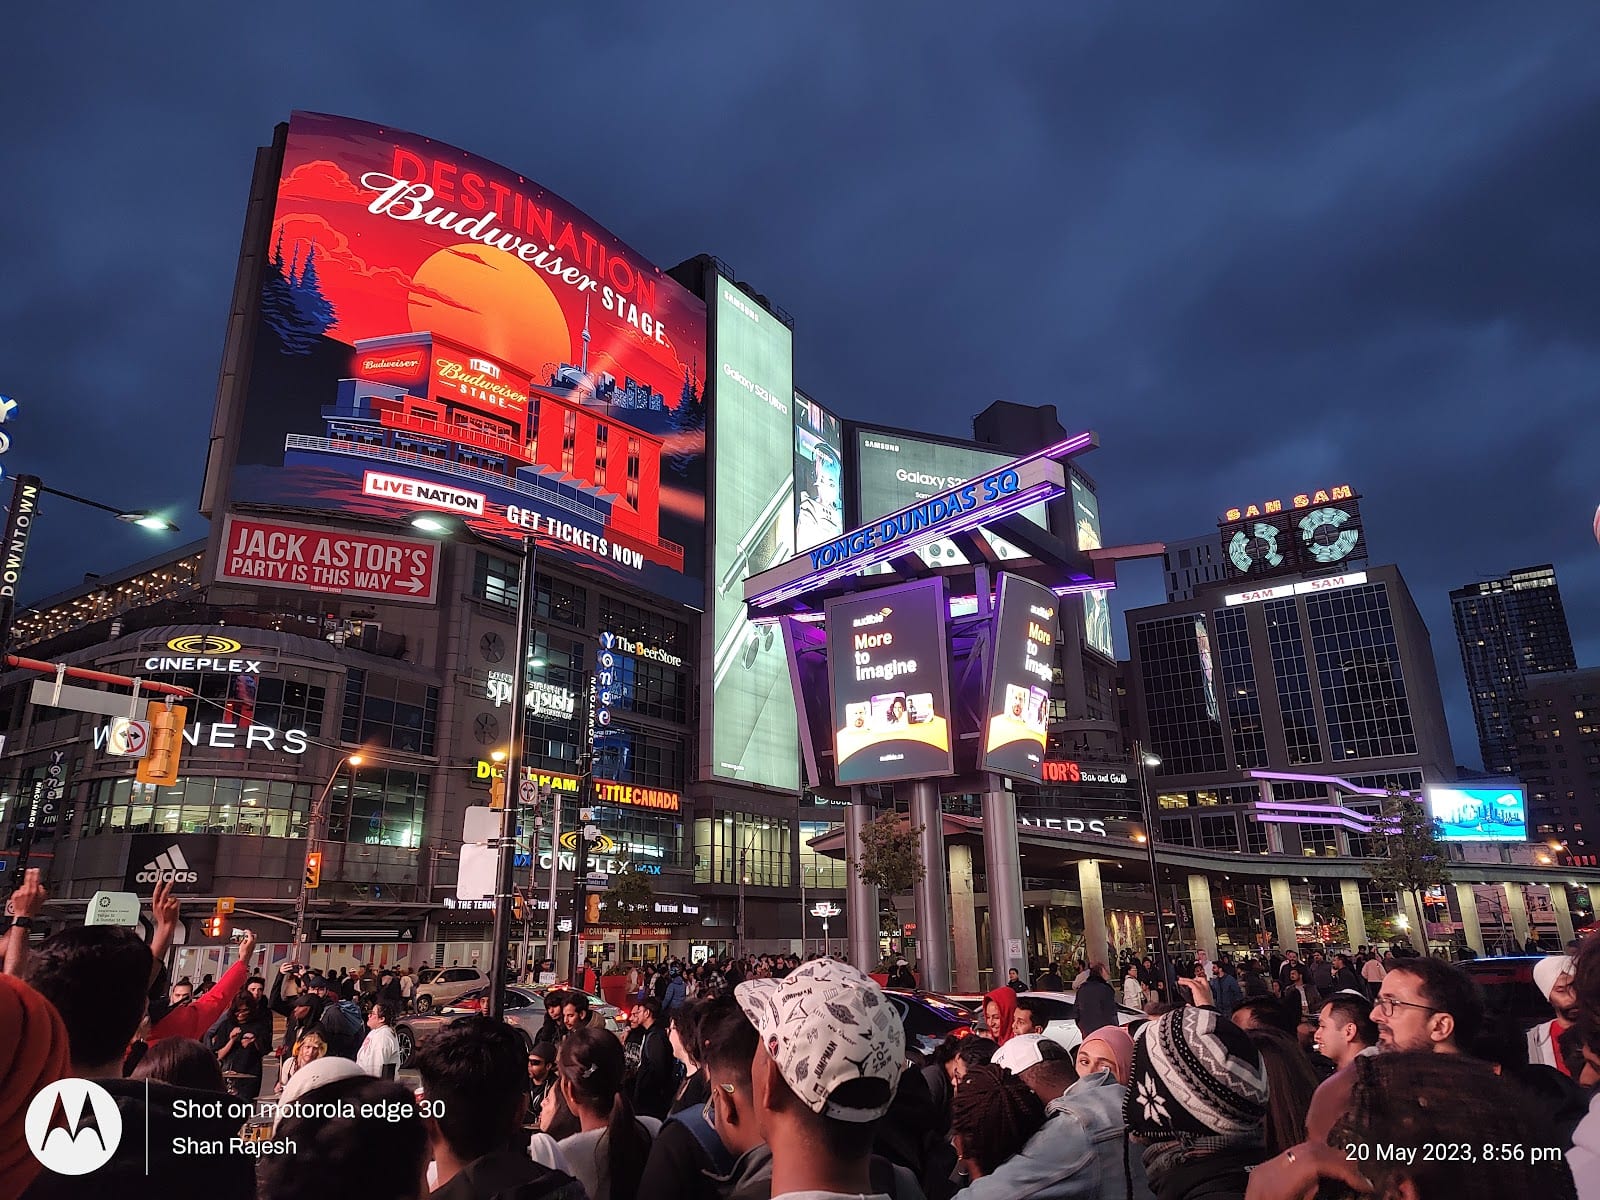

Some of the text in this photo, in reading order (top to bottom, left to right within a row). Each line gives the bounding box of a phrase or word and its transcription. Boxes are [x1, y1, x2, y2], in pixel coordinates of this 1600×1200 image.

[360, 171, 598, 293] Budweiser
[391, 147, 656, 312] DESTINATION
[363, 358, 419, 370] Budweiser
[435, 358, 528, 404] Budweiser
[723, 362, 755, 394] Galaxy
[768, 395, 788, 415] Ultra
[459, 384, 506, 409] STAGE
[864, 439, 900, 452] SAMSUNG
[896, 467, 945, 491] Galaxy
[372, 478, 479, 510] LIVE NATION
[1225, 484, 1353, 522] SAM SAM
[809, 469, 1022, 570] YONGE-DUNDAS SQ
[0, 484, 38, 598] DOWNTOWN
[506, 504, 644, 571] GET TICKETS NOW
[233, 528, 428, 577] JACK ASTOR'S
[230, 556, 289, 579] PARTY
[291, 564, 308, 582] IS
[312, 566, 350, 586] THIS
[354, 571, 392, 590] WAY
[1242, 576, 1346, 602] SAM SAM
[853, 612, 884, 628] audible
[1028, 621, 1051, 646] More
[854, 631, 893, 651] More
[1026, 638, 1038, 657] to
[144, 657, 261, 674] CINEPLEX
[854, 651, 871, 666] to
[856, 659, 918, 681] imagine
[588, 676, 597, 744] DOWNTOWN
[94, 722, 308, 754] WNERS
[1081, 771, 1095, 782] Bar
[1097, 773, 1109, 783] and
[28, 782, 43, 828] DOWNTOWN
[632, 788, 679, 810] CANADA
[135, 868, 198, 884] adidas
[813, 1040, 838, 1080] JUMPMAN
